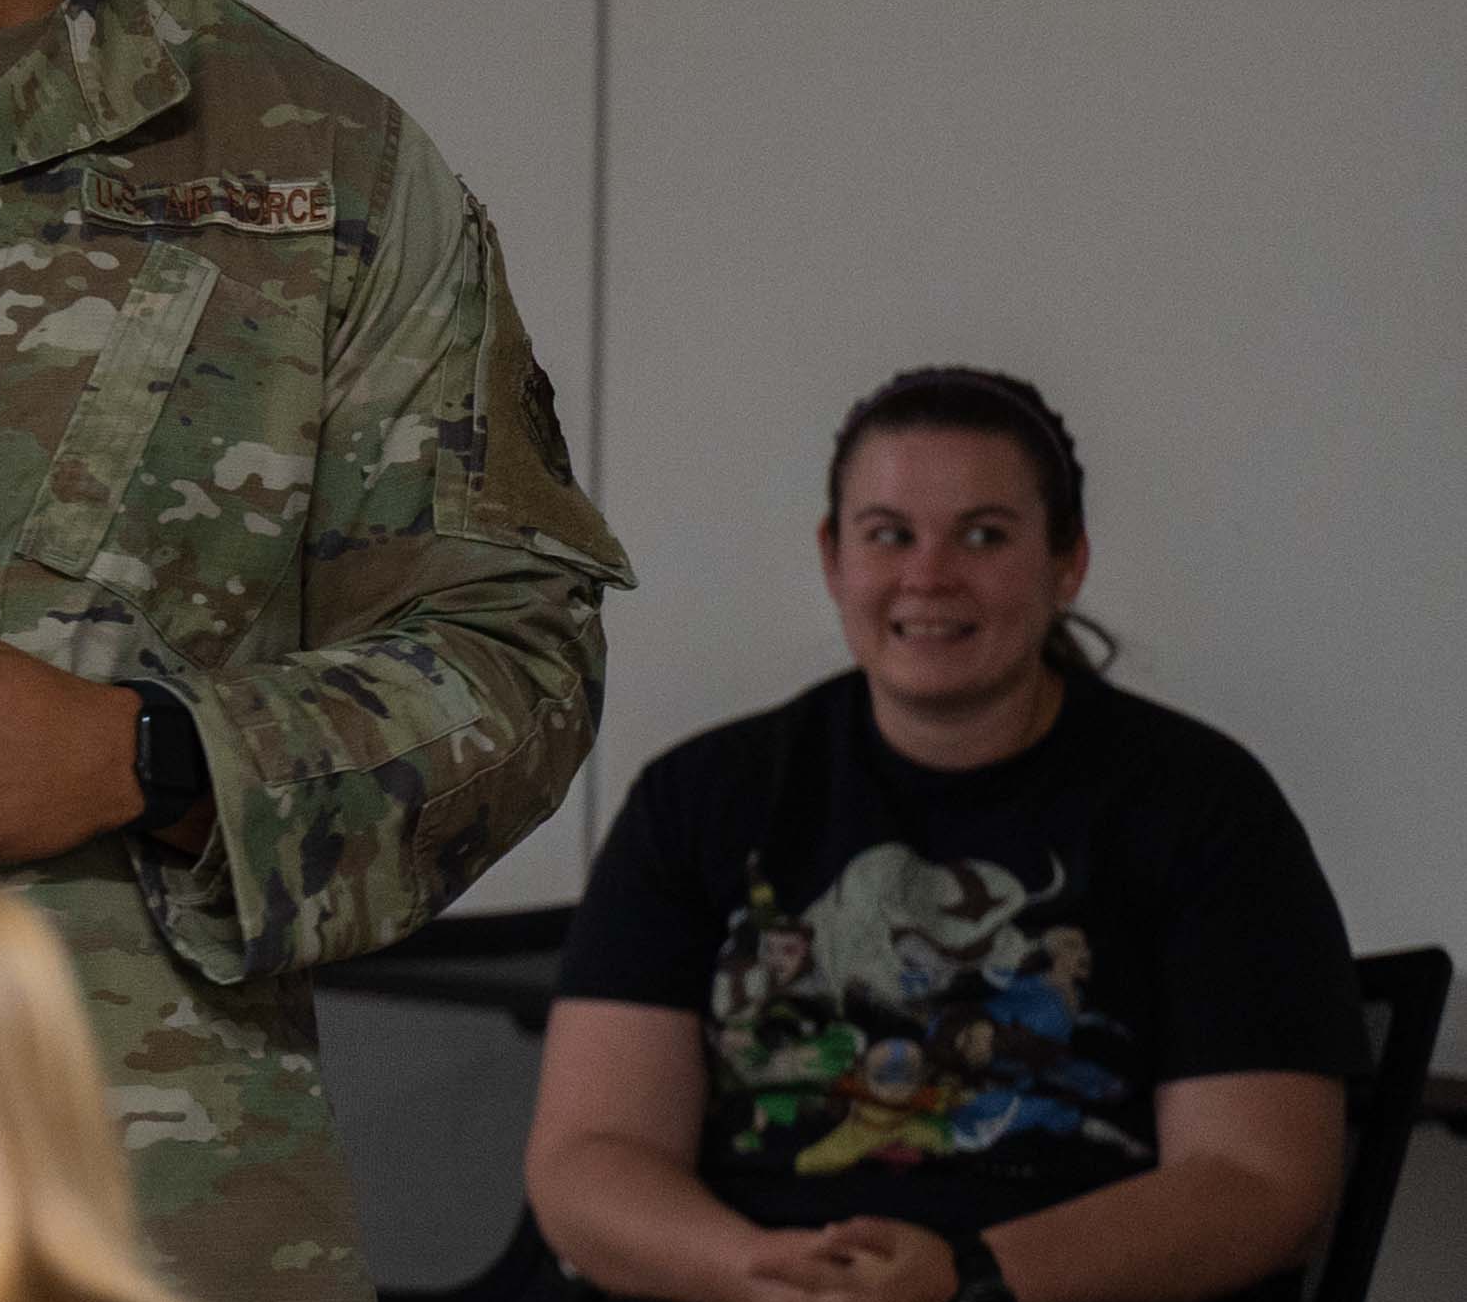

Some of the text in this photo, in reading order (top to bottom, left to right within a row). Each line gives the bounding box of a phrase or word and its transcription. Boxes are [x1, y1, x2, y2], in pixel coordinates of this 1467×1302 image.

[95, 176, 330, 225] U.S. AIR FORCE
